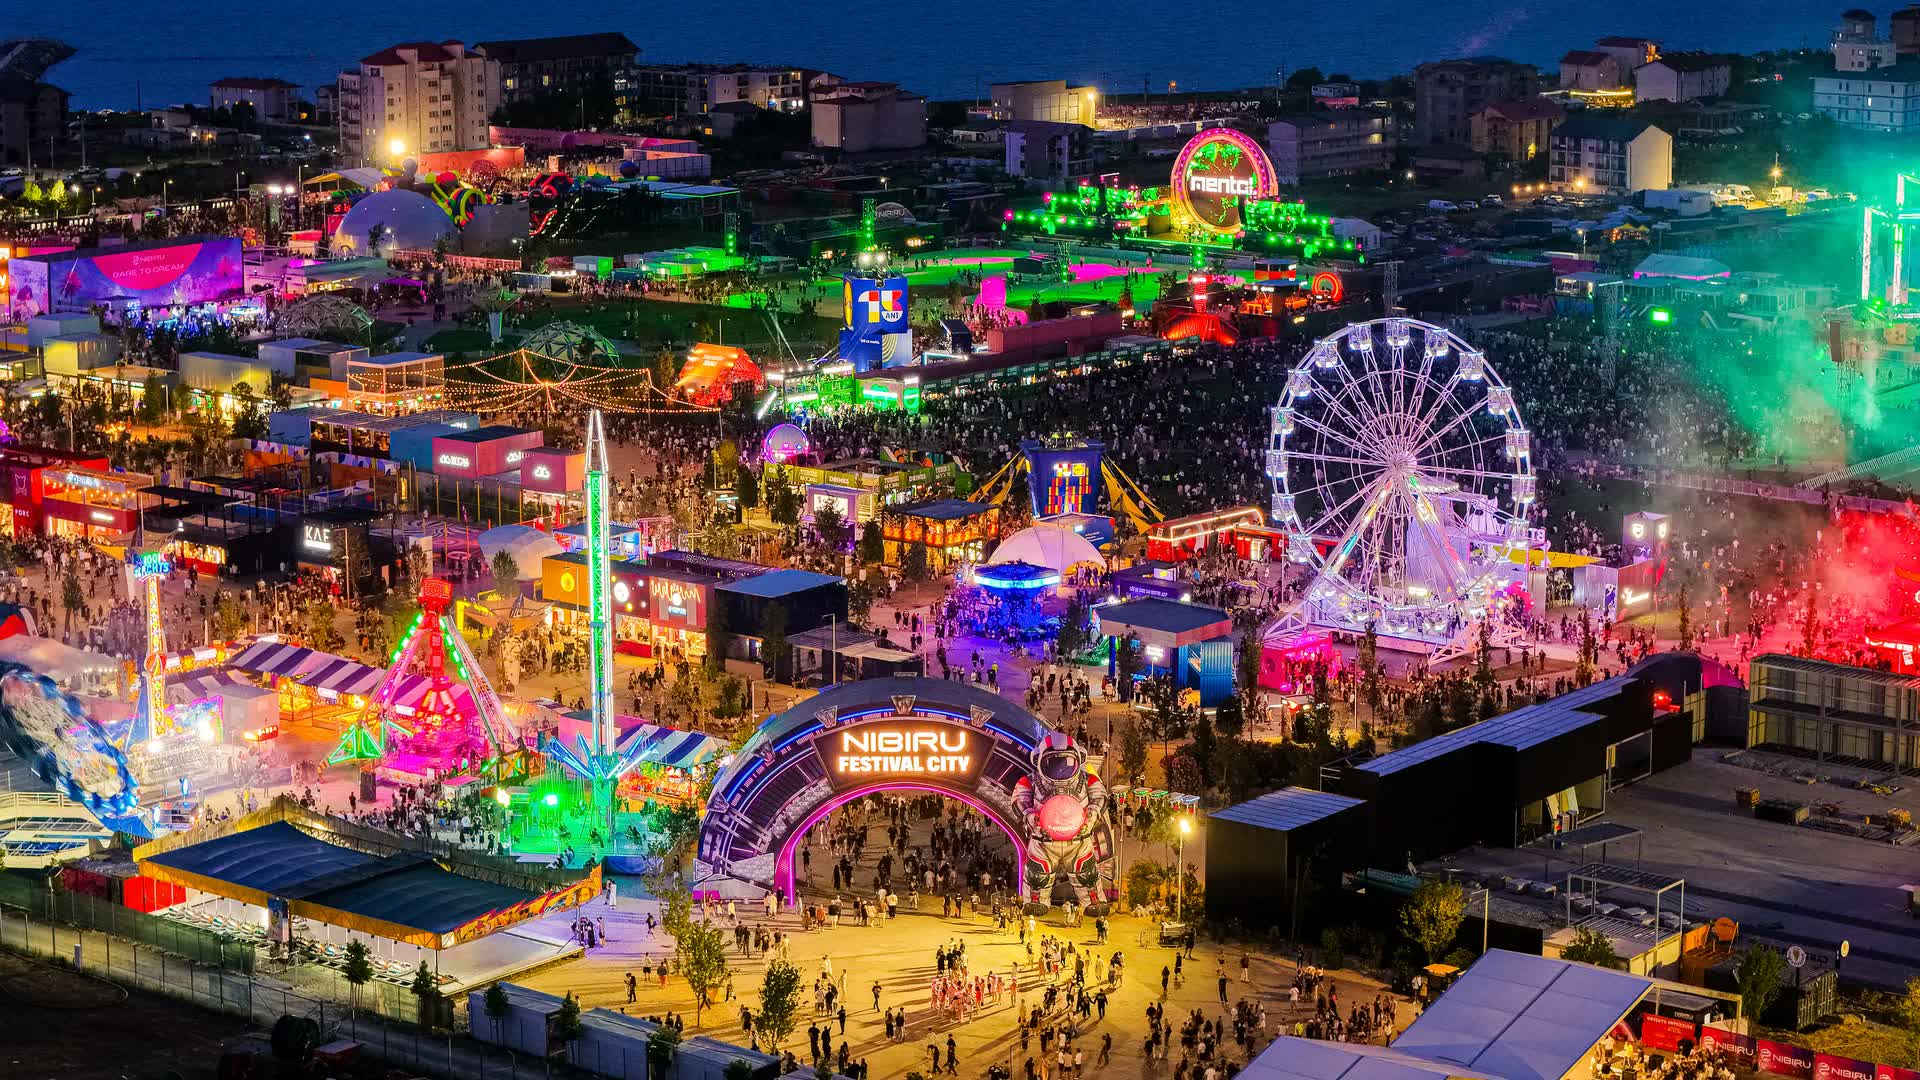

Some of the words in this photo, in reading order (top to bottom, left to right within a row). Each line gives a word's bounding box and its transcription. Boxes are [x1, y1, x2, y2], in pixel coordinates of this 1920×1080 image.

[112, 270, 138, 279] DARE
[140, 267, 152, 275] TO
[152, 263, 185, 273] DREAM
[14, 508, 30, 517] PORC
[843, 731, 967, 753] NIBIRU
[839, 755, 924, 773] FESTIVAL
[926, 755, 970, 772] CITY
[1715, 1042, 1755, 1057] NIBIRU
[1771, 1053, 1813, 1069] NIBIRU
[1830, 1066, 1873, 1080] NIBIRU
